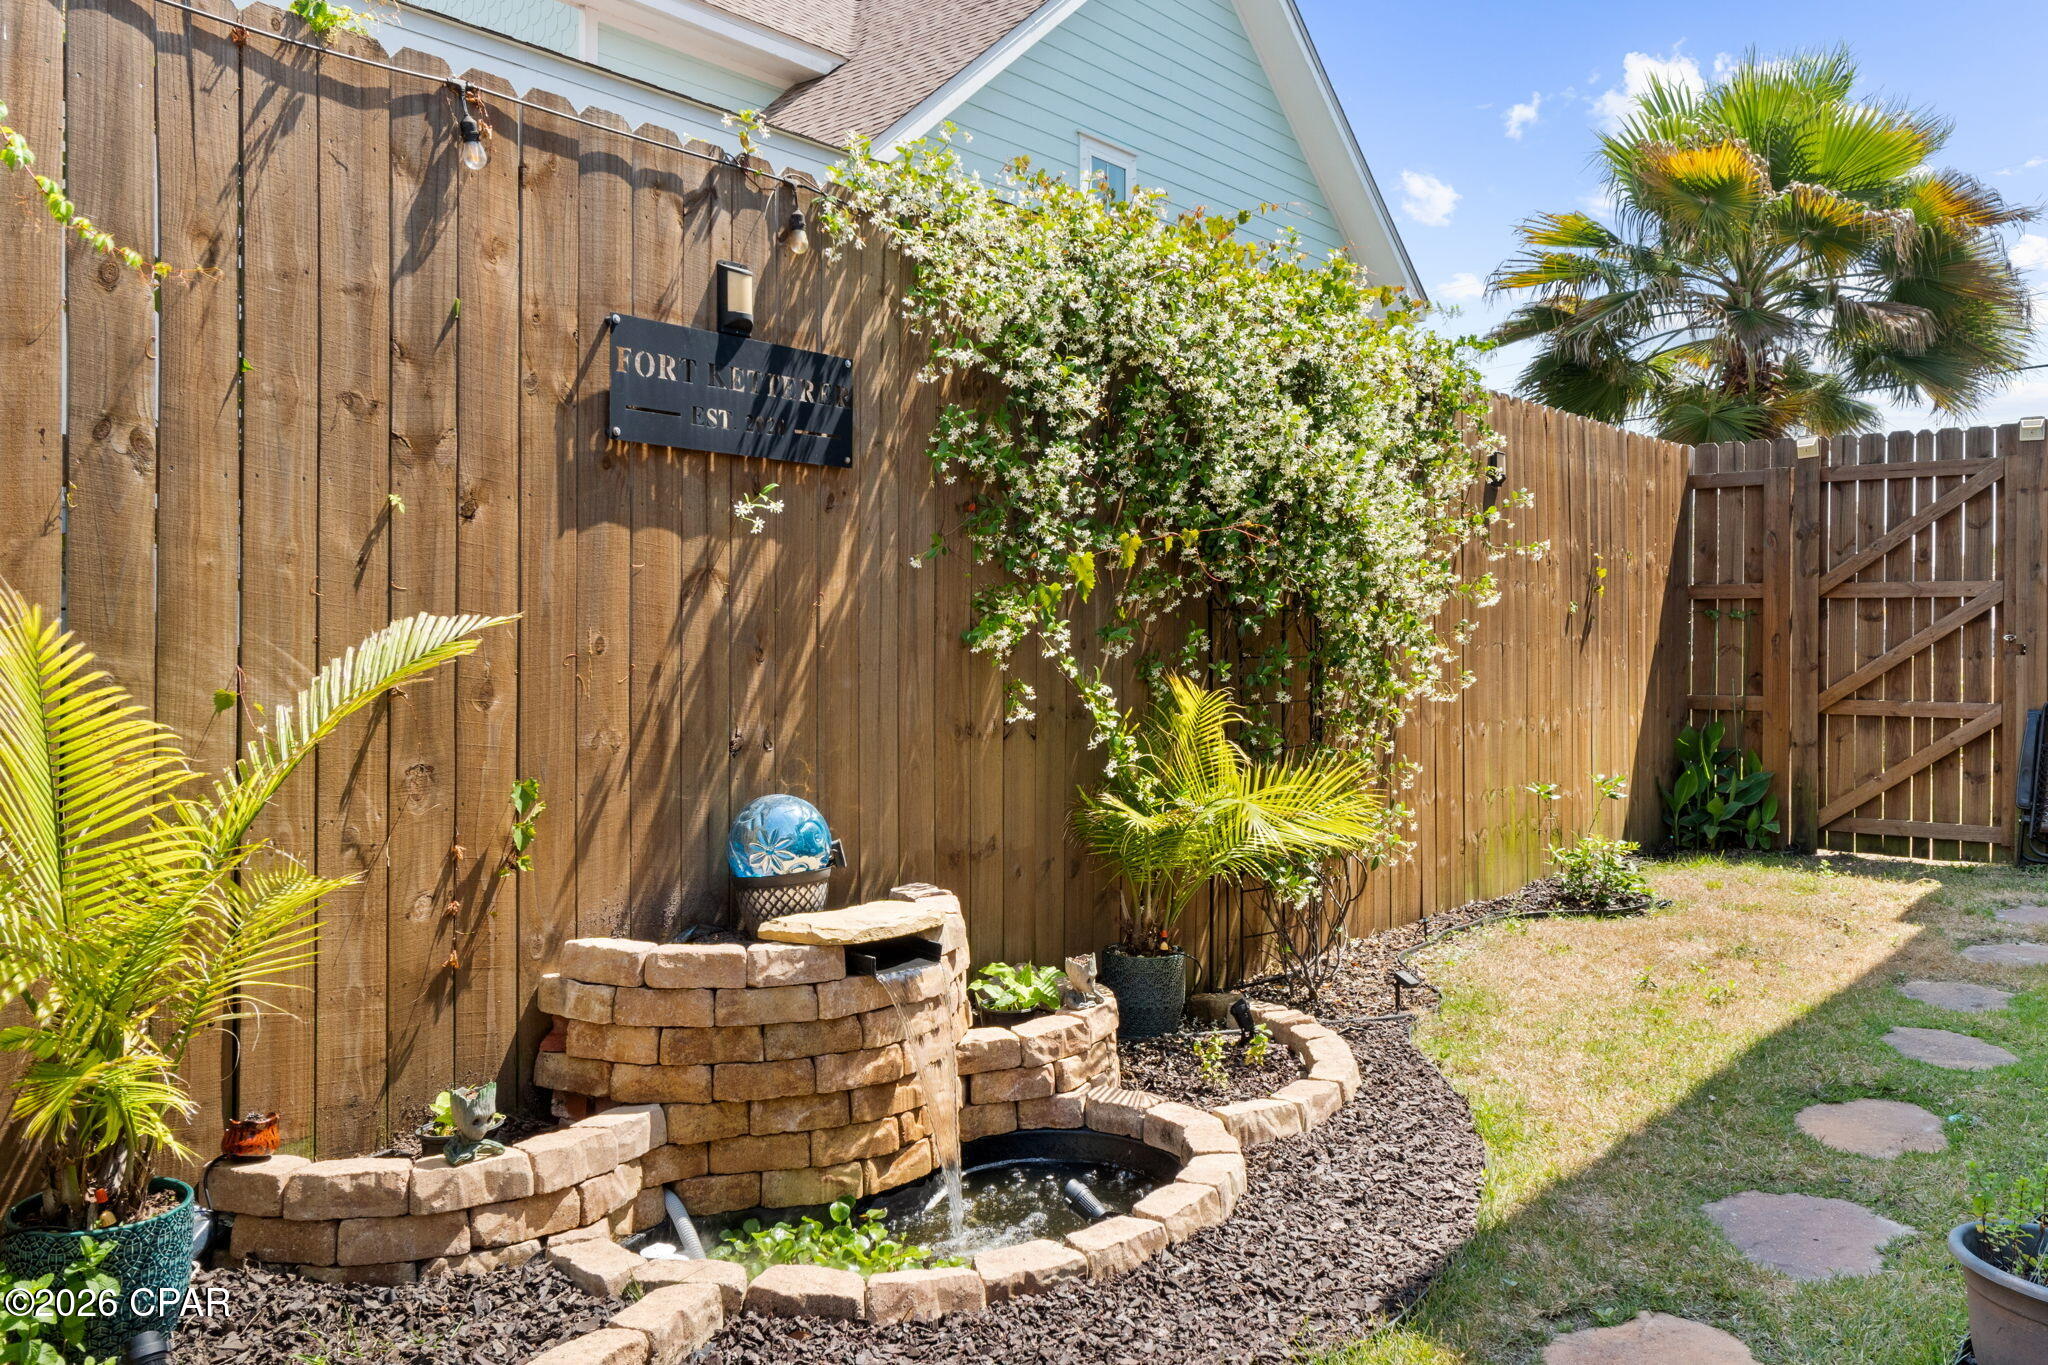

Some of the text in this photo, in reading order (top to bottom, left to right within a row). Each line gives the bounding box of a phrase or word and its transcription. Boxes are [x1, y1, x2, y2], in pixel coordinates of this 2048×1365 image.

[616, 346, 852, 408] FORT KETTERER
[692, 406, 736, 430] EST.
